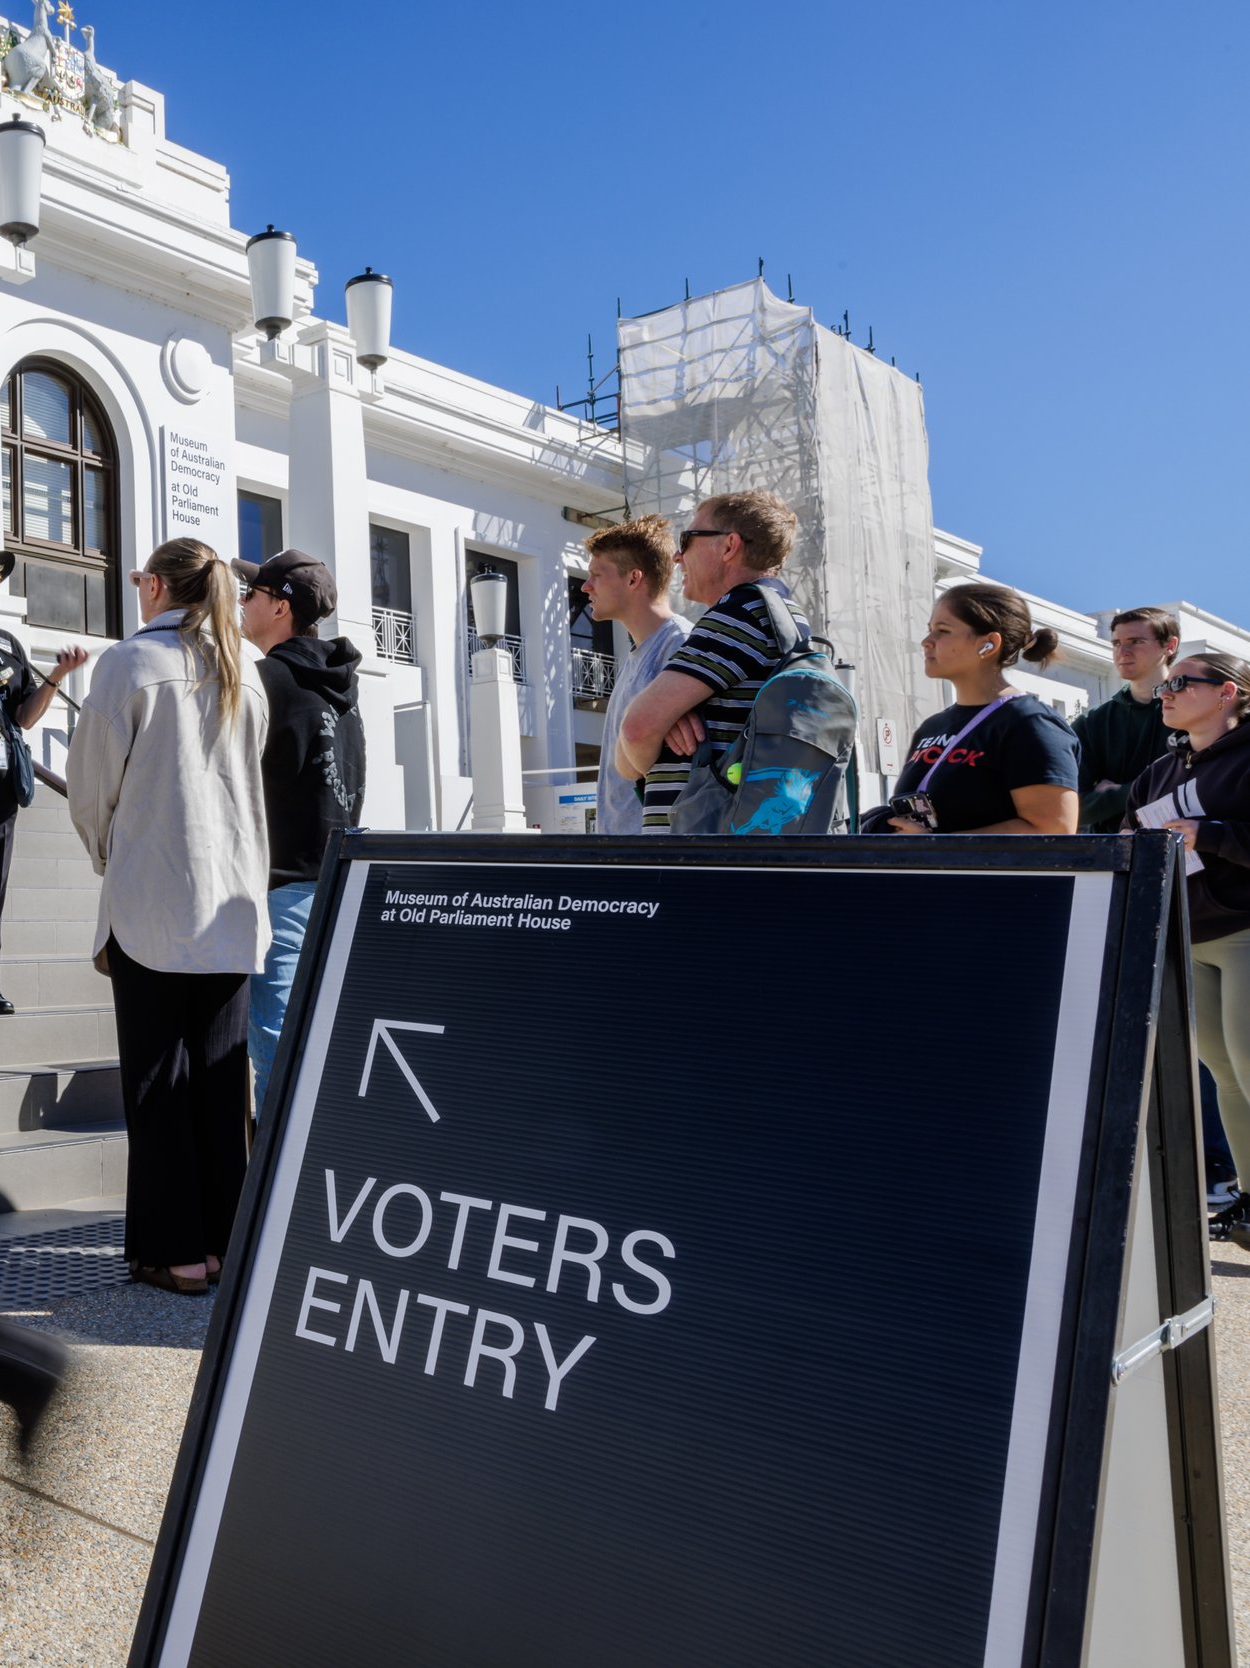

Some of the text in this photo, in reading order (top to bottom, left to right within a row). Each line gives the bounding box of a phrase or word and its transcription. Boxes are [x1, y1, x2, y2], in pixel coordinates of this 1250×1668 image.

[45, 94, 86, 117] AUSTRALI
[170, 432, 208, 452] Museum
[170, 447, 226, 471] of Australian
[170, 460, 221, 486] Democracy
[171, 482, 198, 497] at Old
[172, 495, 219, 517] Parliament
[172, 509, 201, 526] House
[908, 746, 985, 767] CCK
[385, 890, 660, 918] Museum of Australian Democracy
[380, 907, 572, 931] at Old Parliament House
[325, 1168, 676, 1315] VOTERS
[295, 1265, 597, 1412] ENTRY
